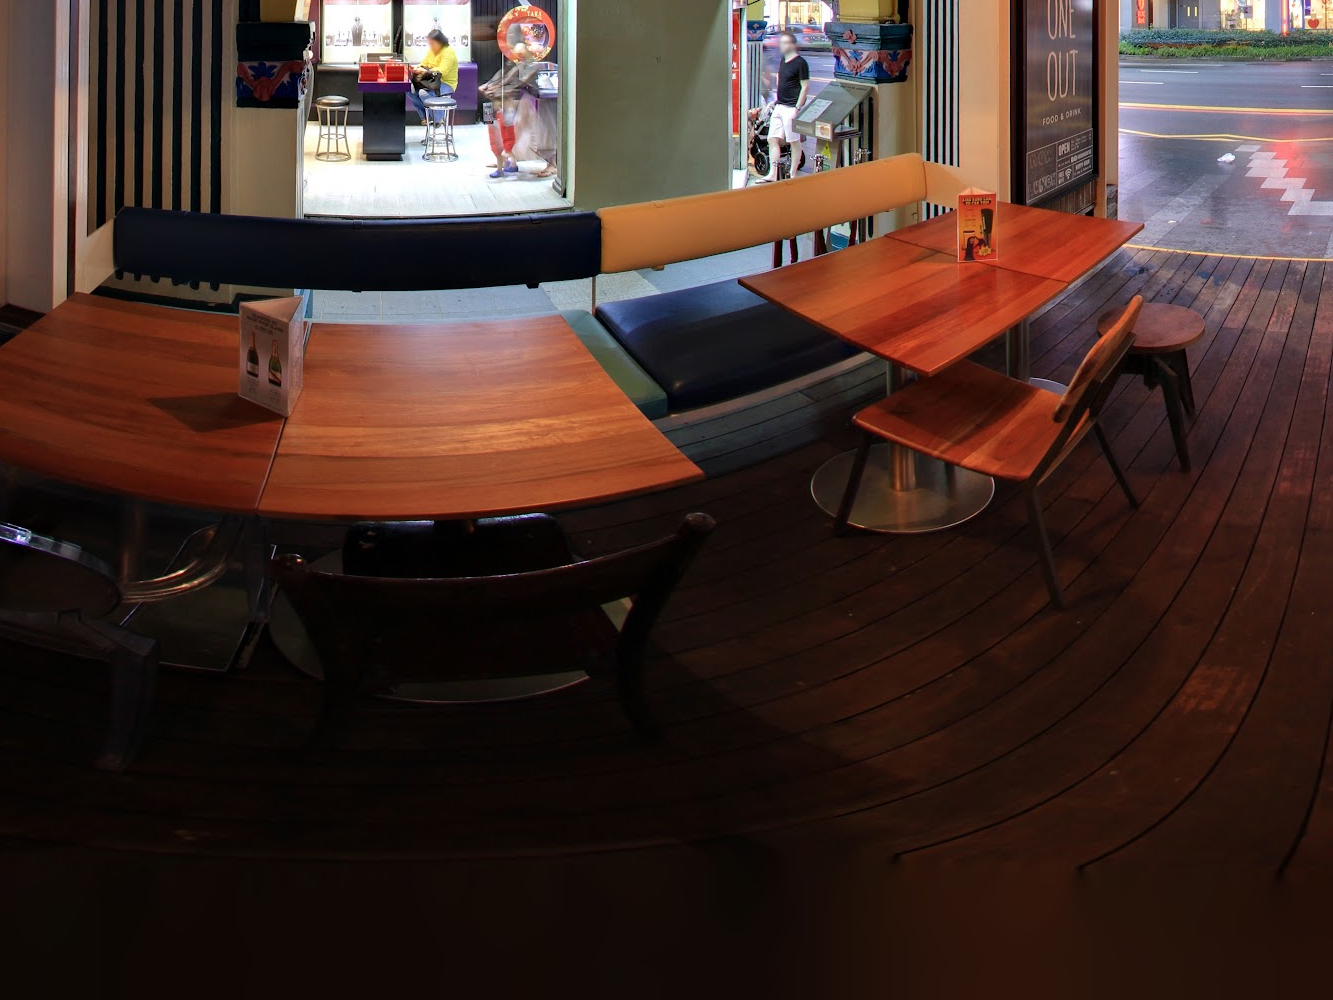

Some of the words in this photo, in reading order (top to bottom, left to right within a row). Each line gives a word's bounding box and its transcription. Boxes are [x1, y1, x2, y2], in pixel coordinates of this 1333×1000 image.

[1047, 49, 1078, 101] OUT
[1042, 115, 1059, 126] FOOD
[1065, 108, 1082, 119] DRINK
[1058, 141, 1071, 156] OPEN
